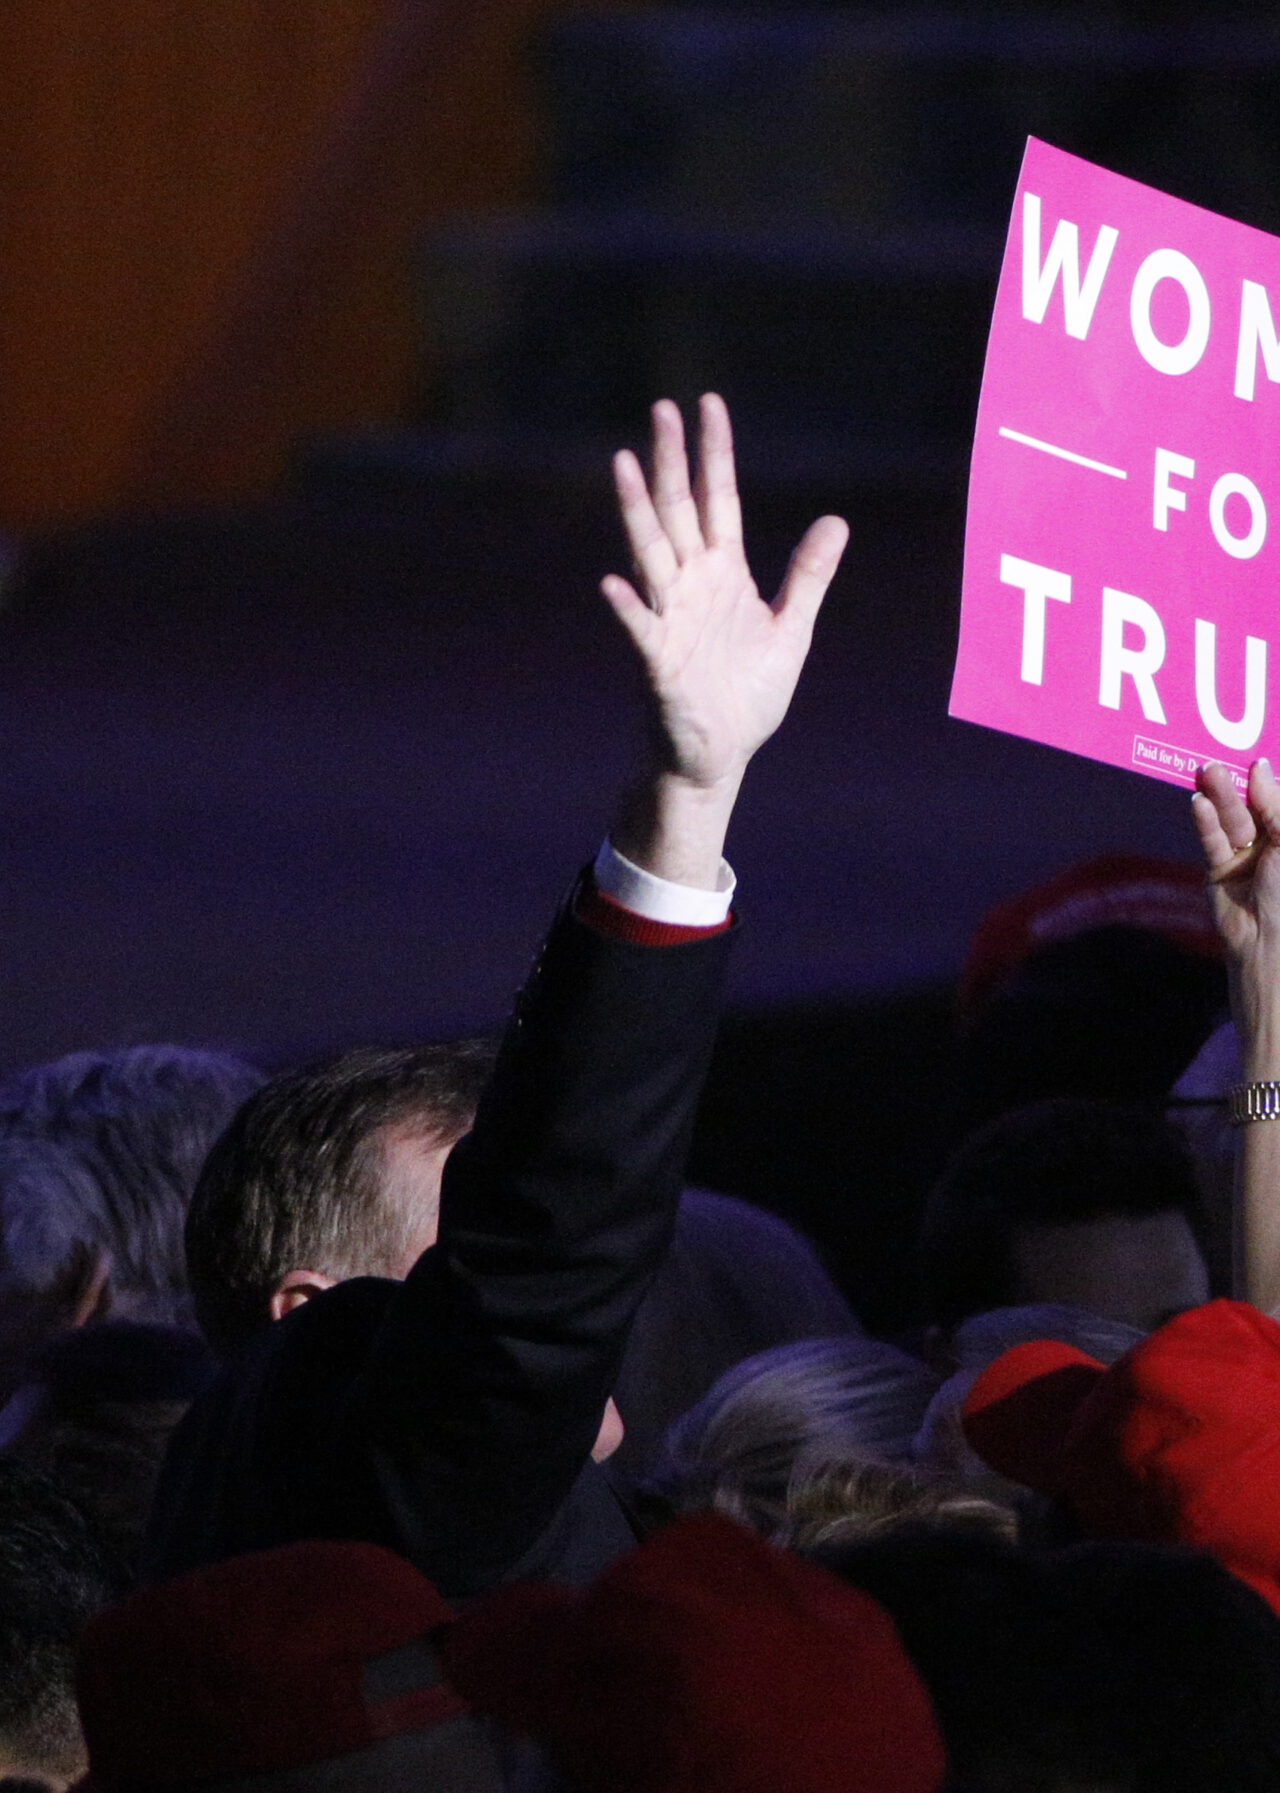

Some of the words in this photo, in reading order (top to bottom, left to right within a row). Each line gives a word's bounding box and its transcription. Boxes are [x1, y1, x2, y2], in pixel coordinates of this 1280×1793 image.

[1136, 742, 1158, 761] Paid
[1159, 749, 1173, 765] for
[1174, 753, 1185, 772] by
[1229, 770, 1249, 788] Tru
